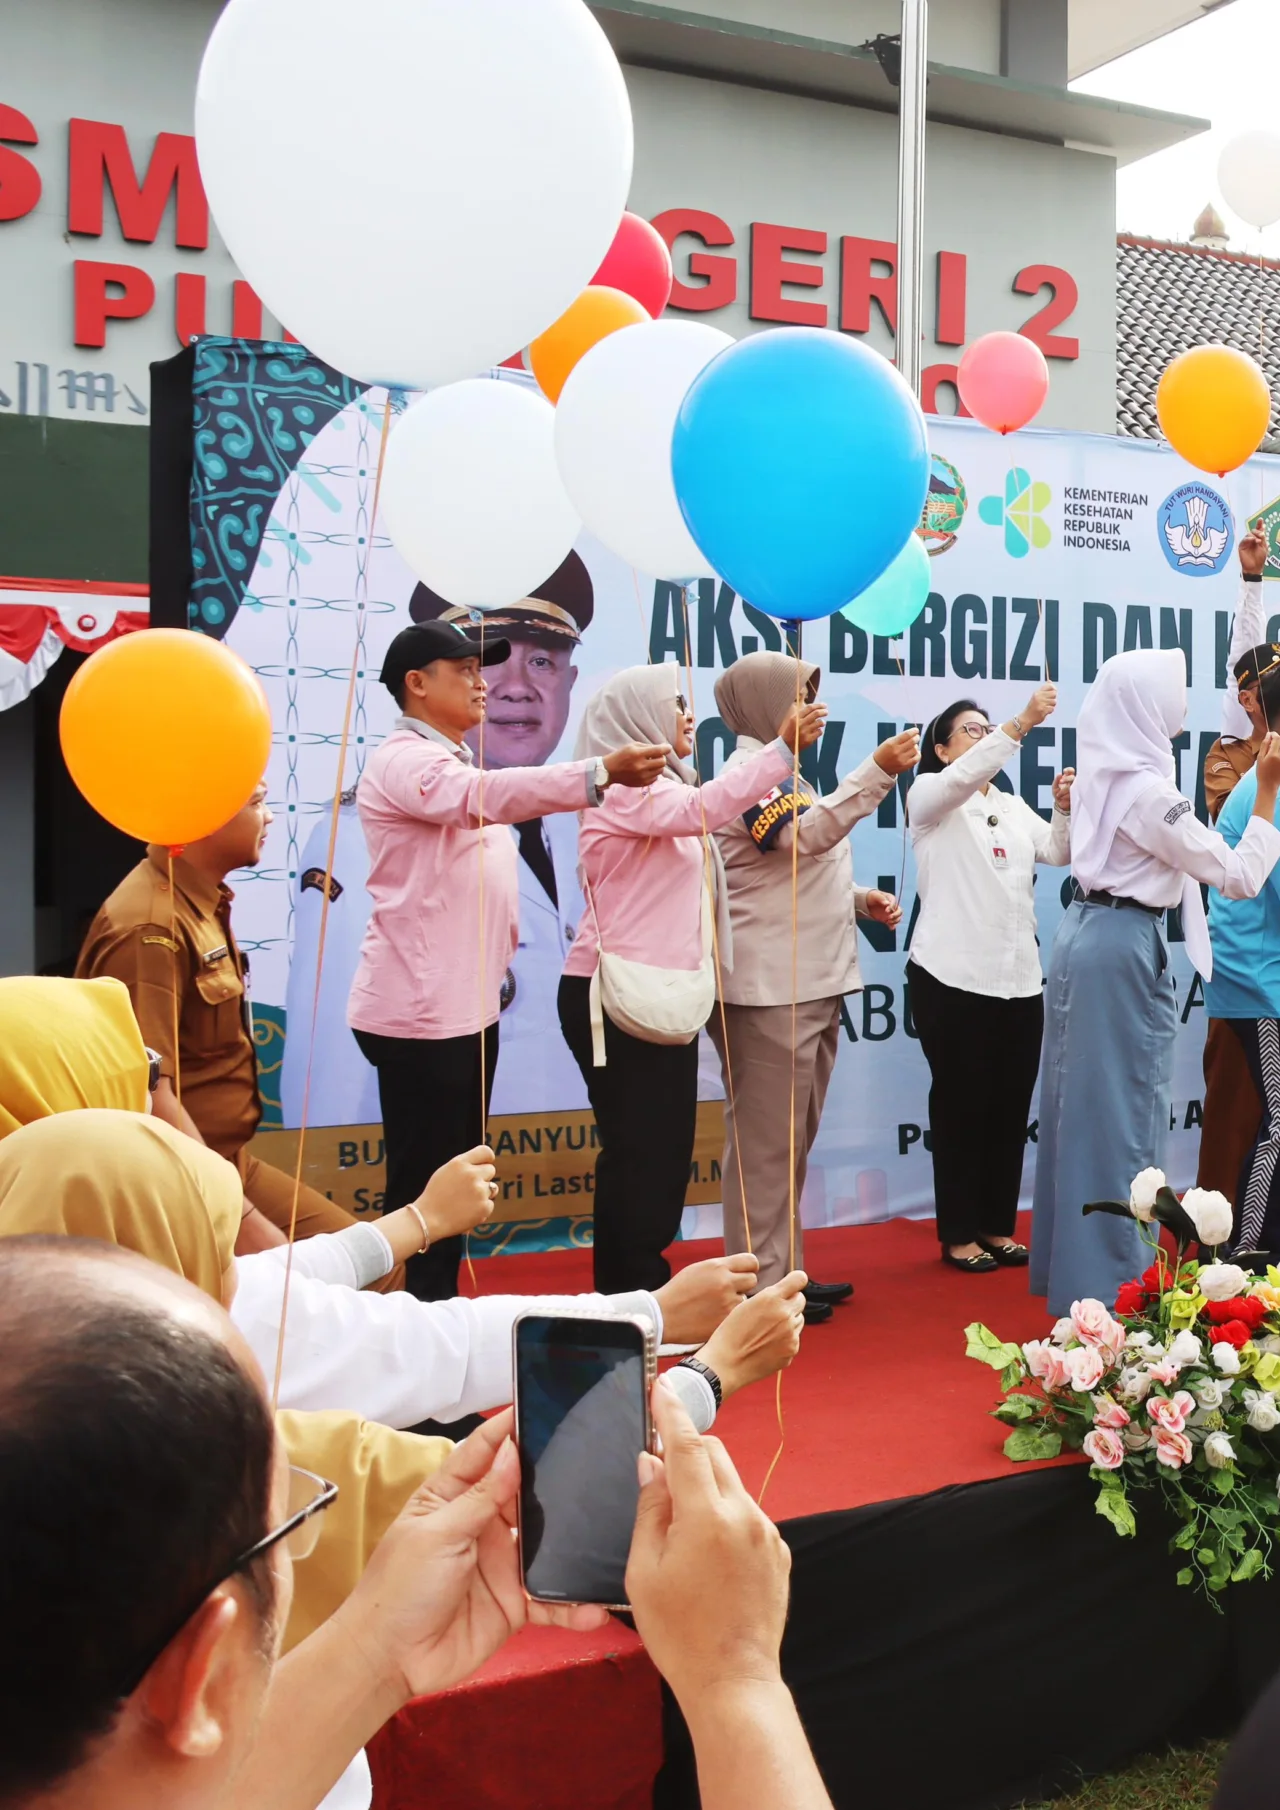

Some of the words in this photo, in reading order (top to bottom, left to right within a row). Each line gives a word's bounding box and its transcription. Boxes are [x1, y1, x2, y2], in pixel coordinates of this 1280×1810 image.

[0, 103, 209, 250] SM
[1012, 264, 1079, 360] 2
[1064, 486, 1148, 506] KEMENTERIAN
[1164, 495, 1177, 512] TUT
[1175, 486, 1194, 499] WURI
[1195, 486, 1229, 518] HANDAYANI
[1064, 502, 1133, 520] KESEHATAN
[1063, 518, 1120, 535] REPUBLIK
[1063, 534, 1131, 552] INDONESIA
[534, 1171, 595, 1197] Last
